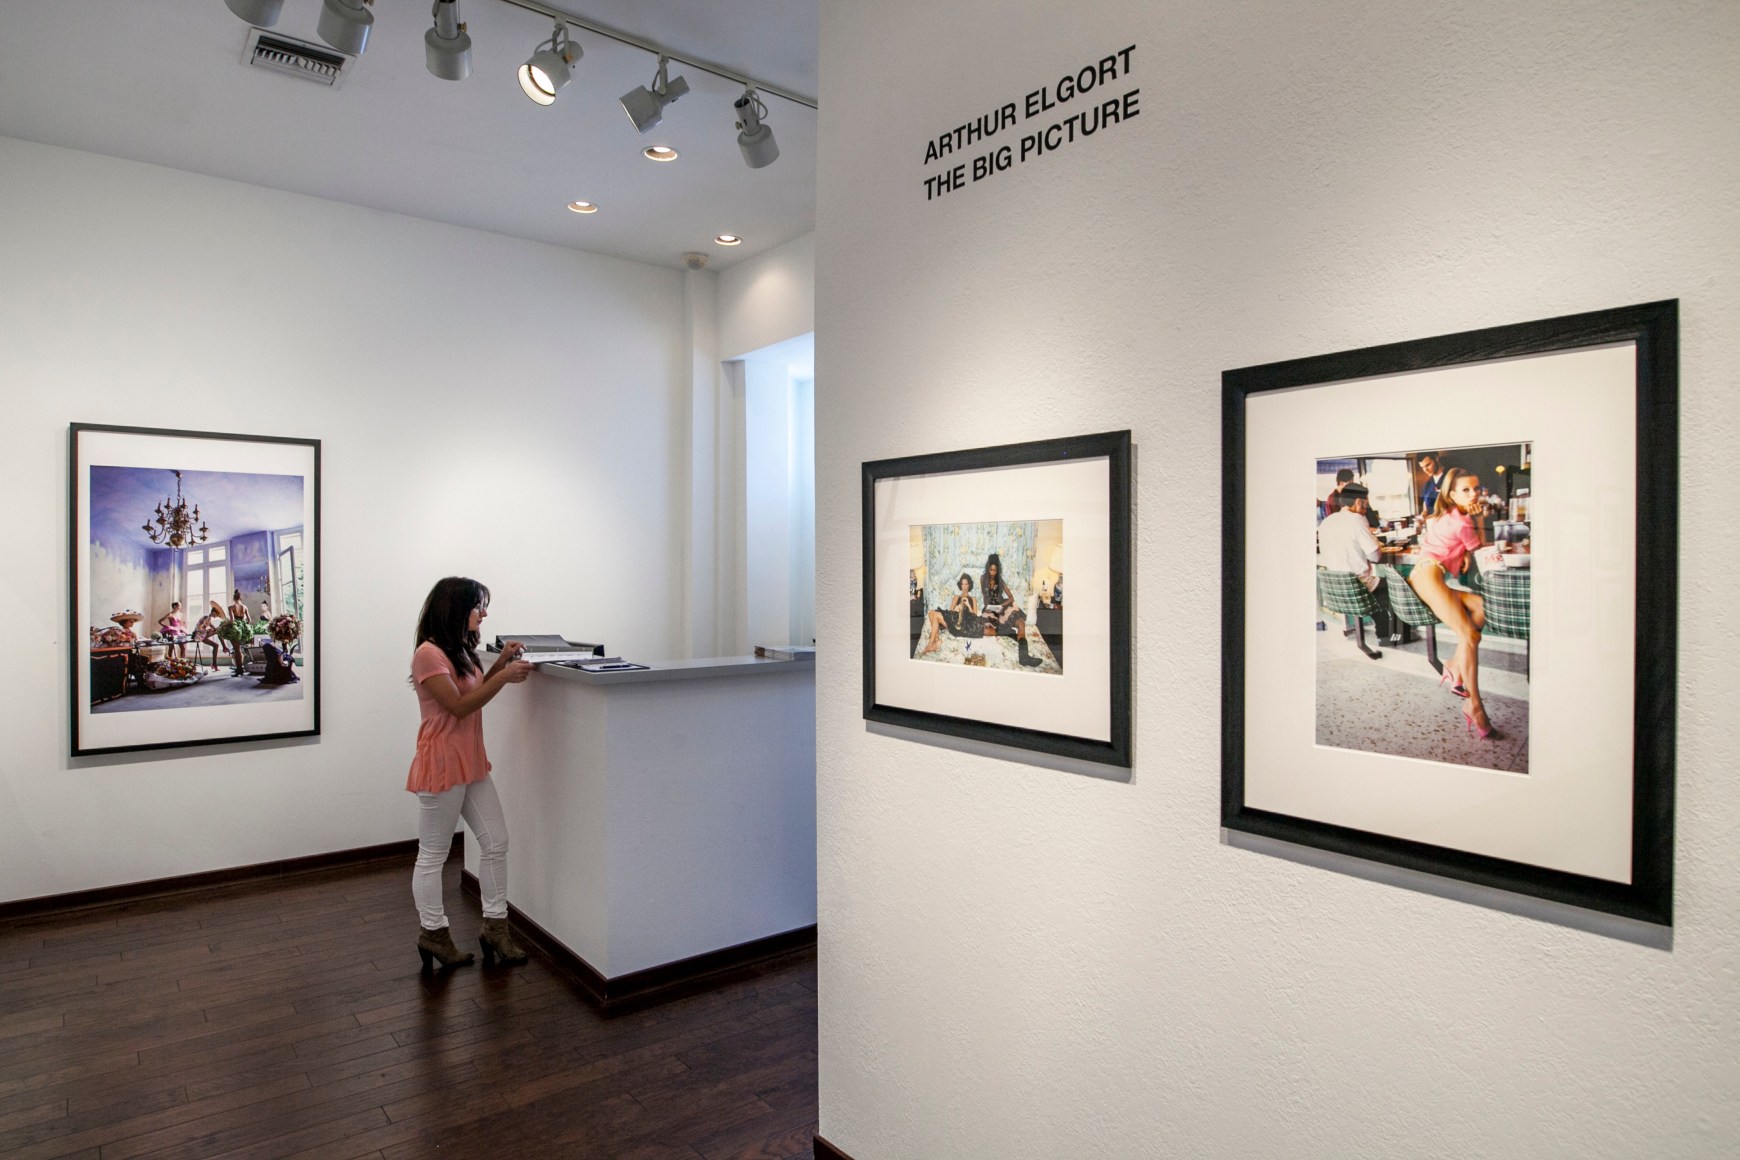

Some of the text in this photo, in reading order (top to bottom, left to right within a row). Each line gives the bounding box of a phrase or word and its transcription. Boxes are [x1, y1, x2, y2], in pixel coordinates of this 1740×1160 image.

[923, 44, 1136, 165] ARTHUR ELGORT
[923, 88, 1140, 201] THE BIG PICTURE
